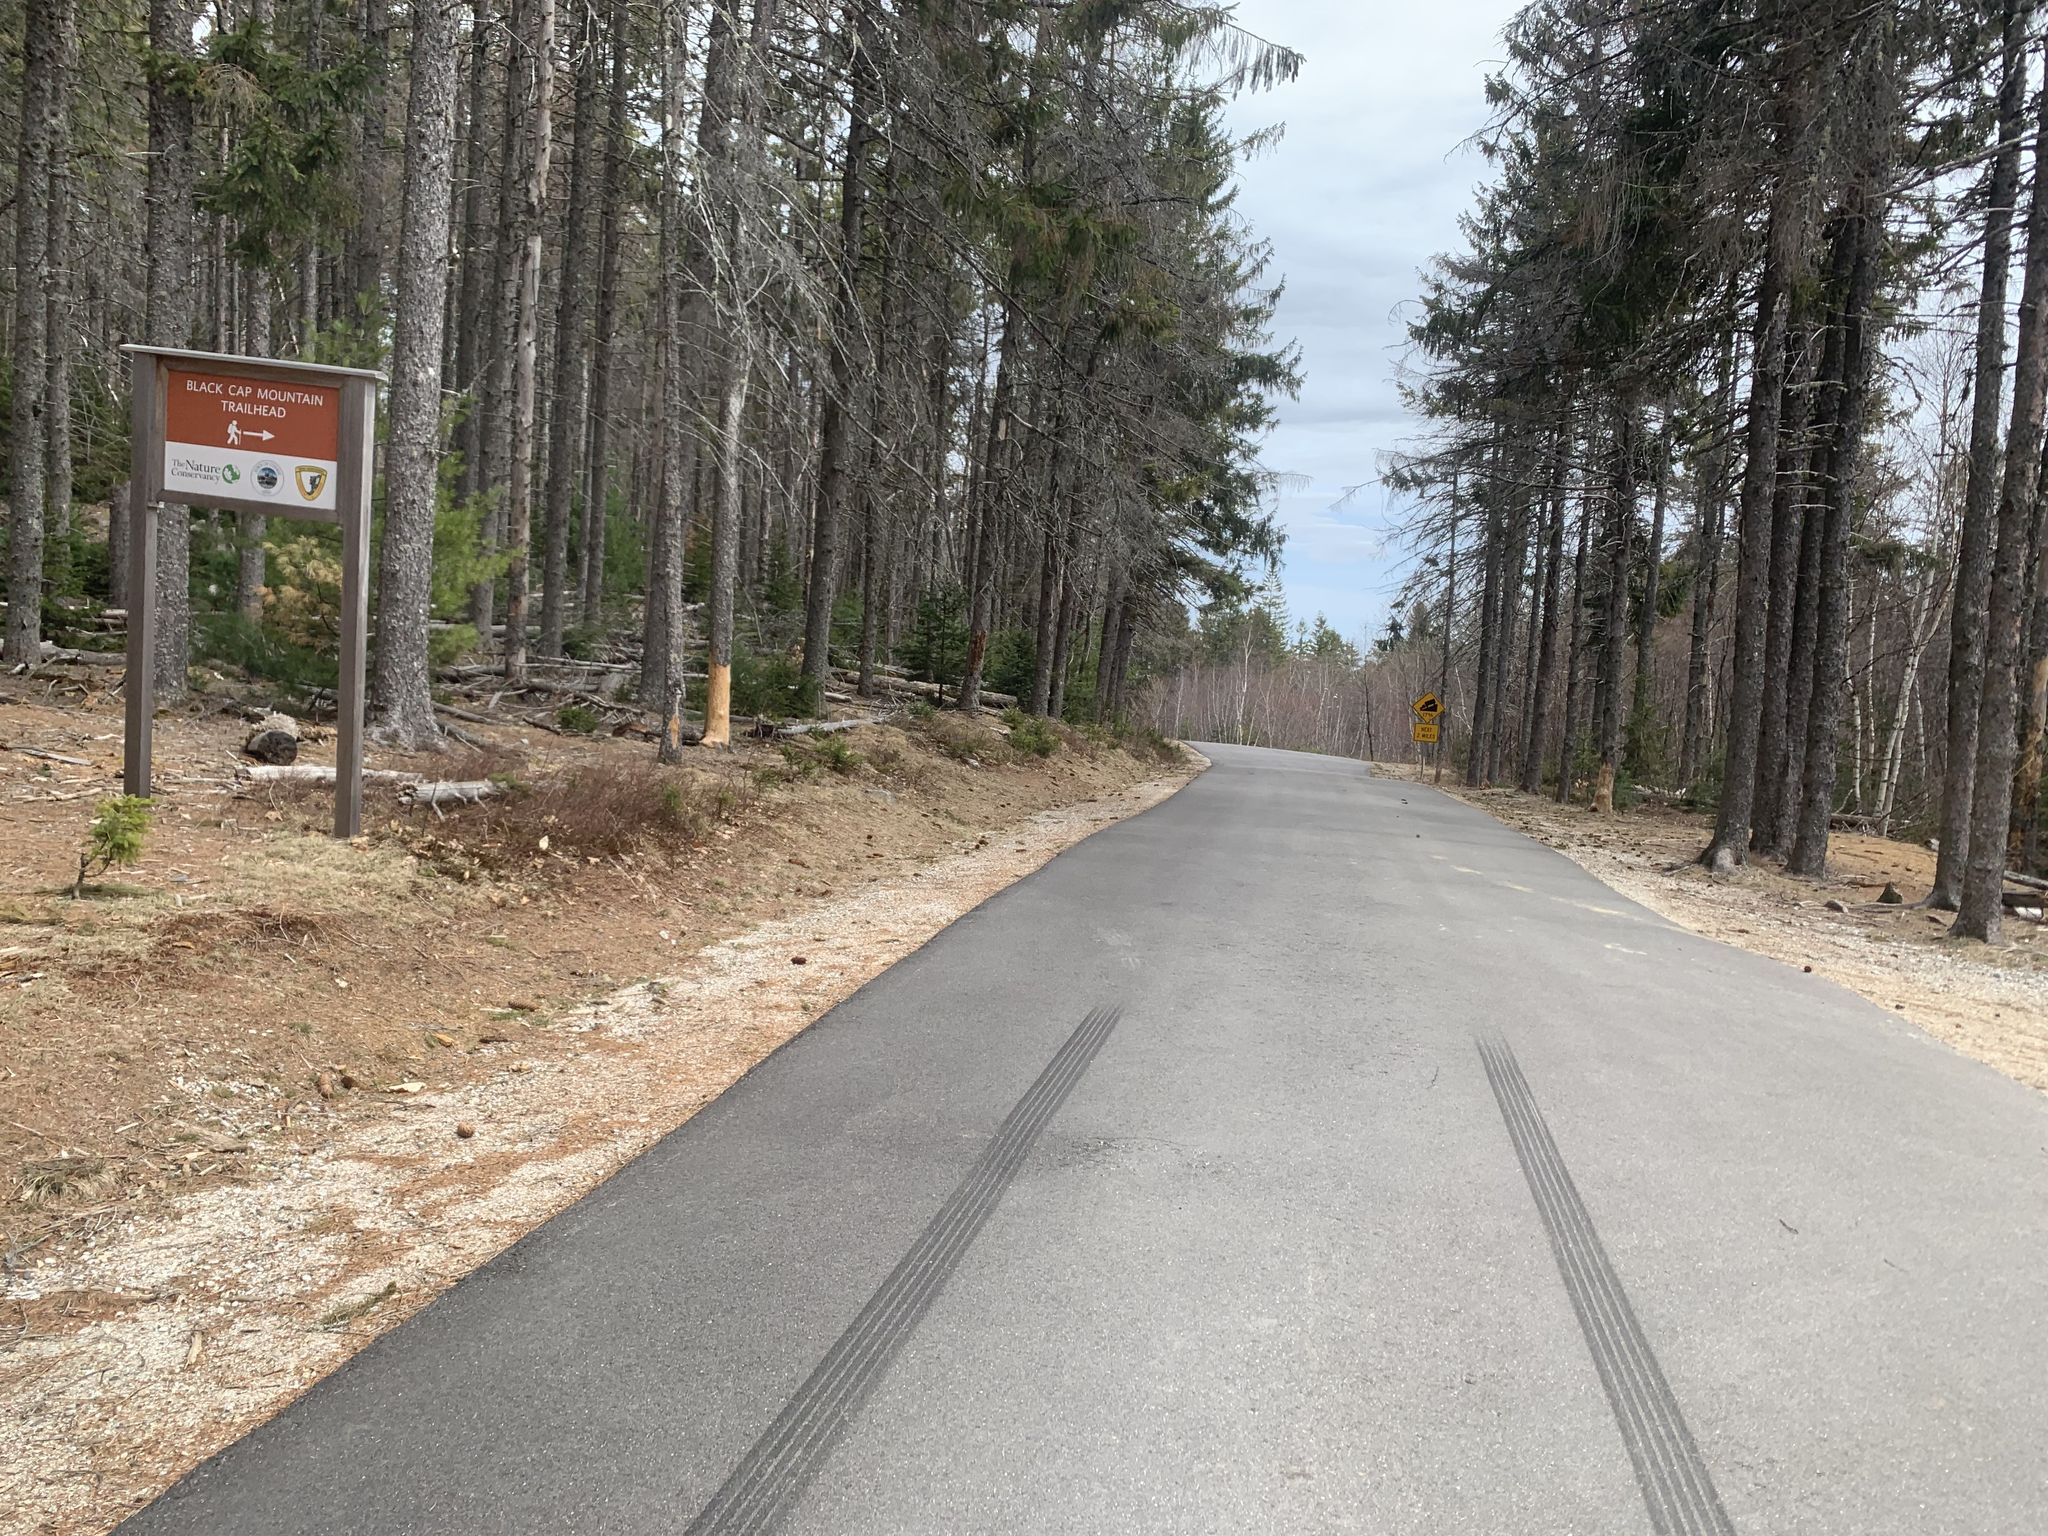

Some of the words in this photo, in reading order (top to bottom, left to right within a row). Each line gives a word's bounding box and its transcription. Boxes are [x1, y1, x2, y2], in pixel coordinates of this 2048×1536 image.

[186, 379, 223, 395] BLACK
[228, 384, 252, 397] CAP
[257, 388, 324, 406] MOUNTAIN
[221, 400, 286, 418] TRAILHEAD
[171, 458, 185, 468] The
[185, 459, 221, 474] Nature
[171, 467, 220, 484] Conservancy
